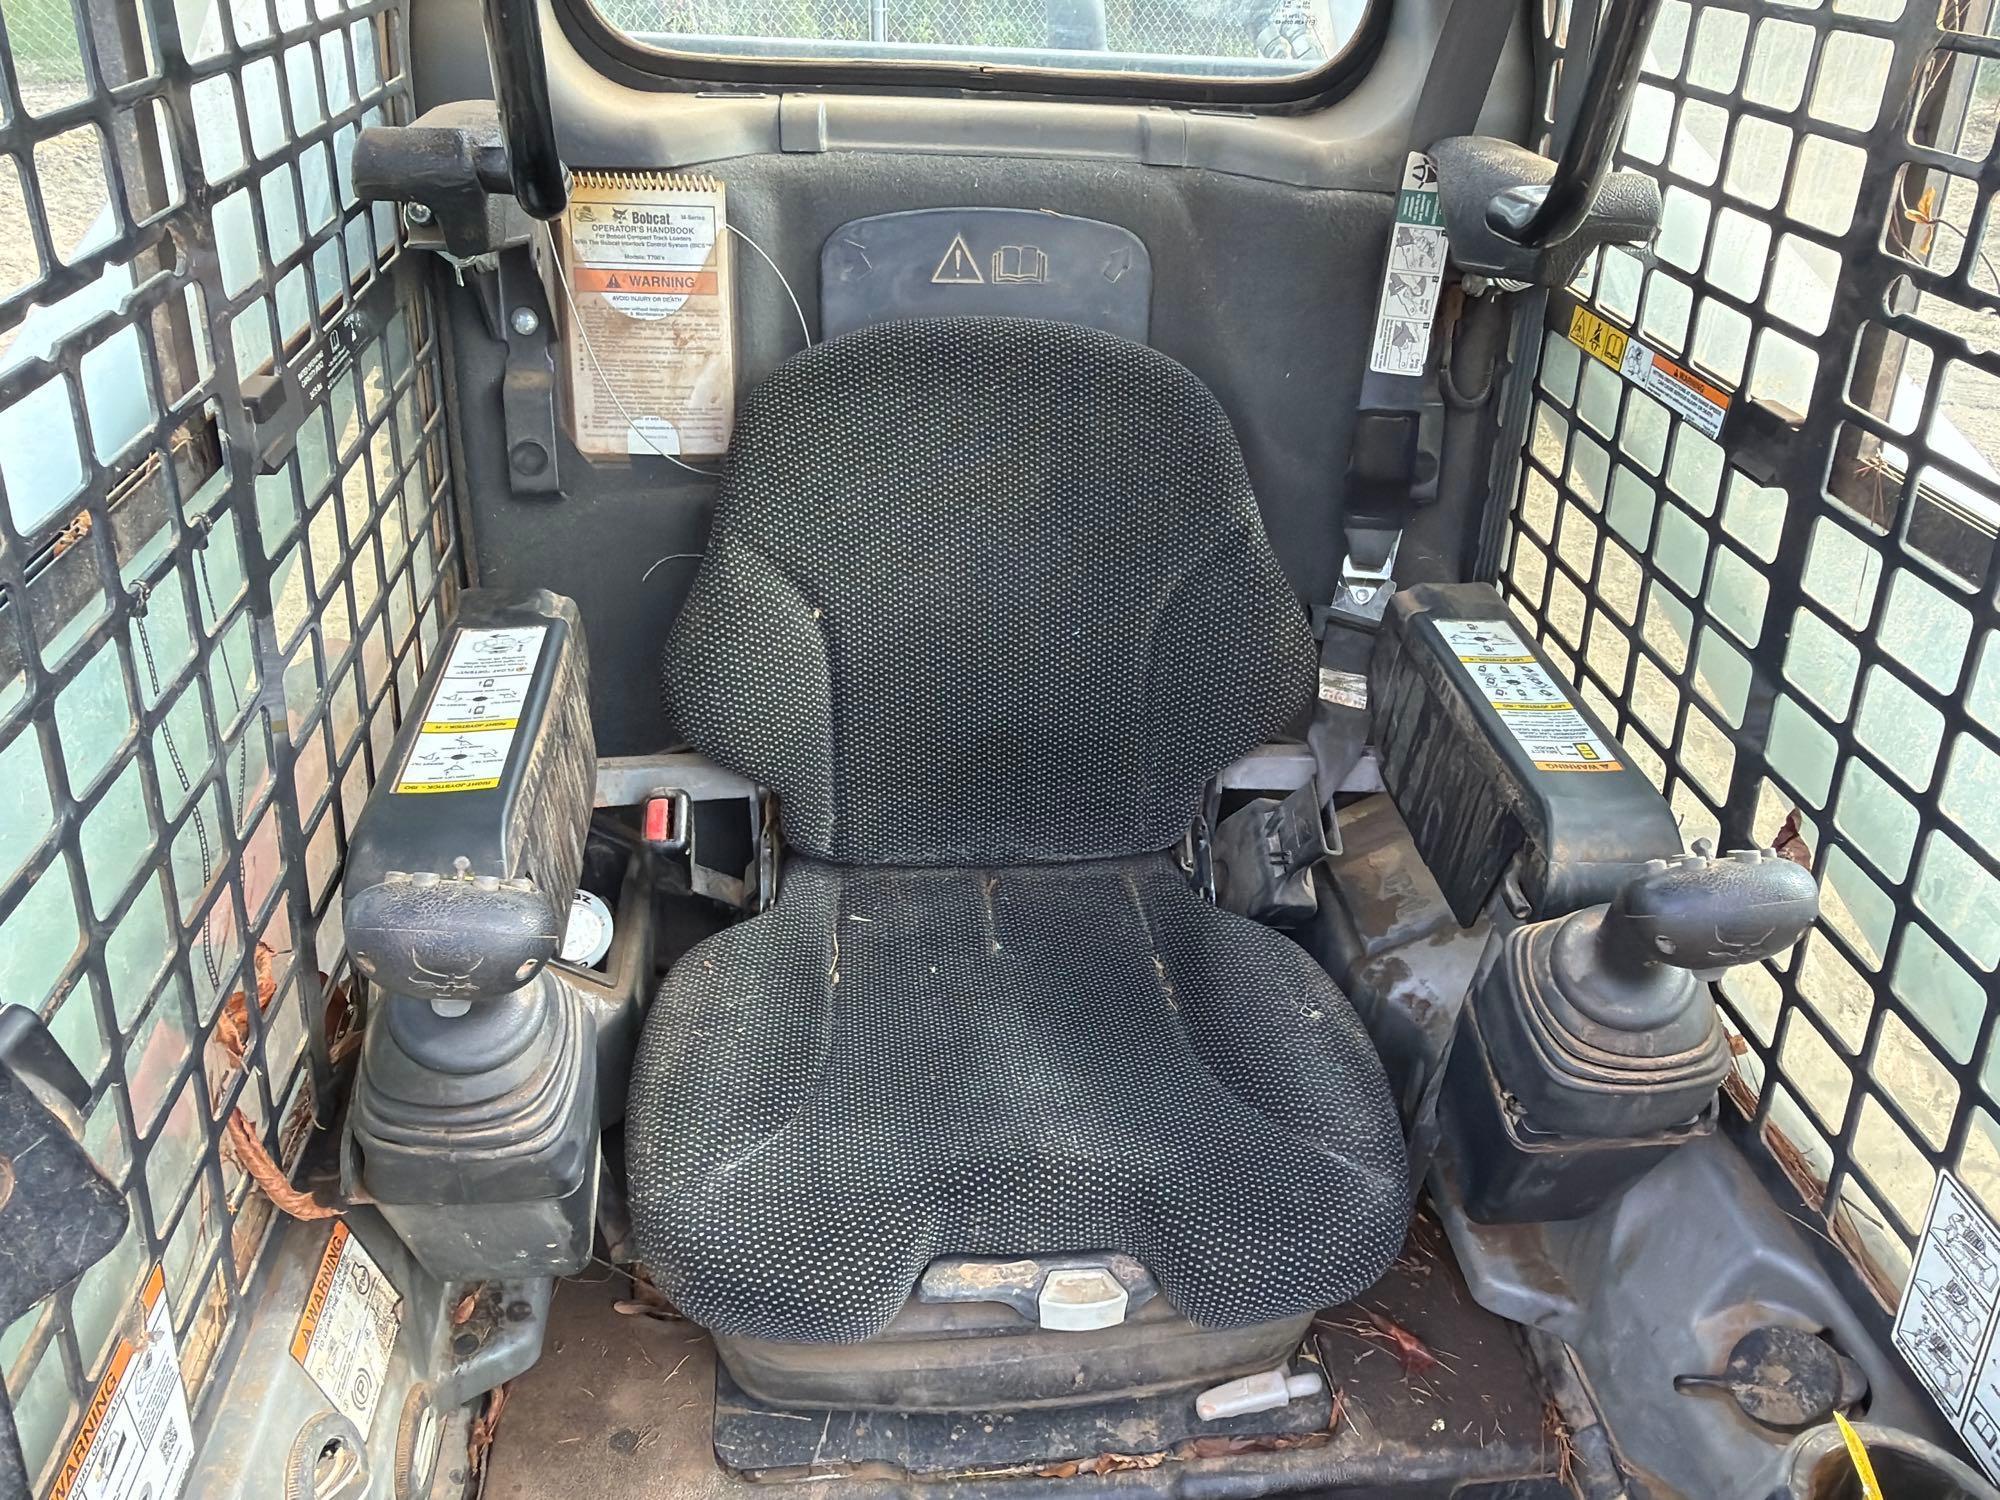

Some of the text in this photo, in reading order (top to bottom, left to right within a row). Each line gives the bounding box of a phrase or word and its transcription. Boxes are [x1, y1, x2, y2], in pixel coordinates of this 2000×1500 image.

[592, 224, 695, 235] OPERATOR'S HANDBOOK
[632, 212, 671, 226] Bobcat
[627, 234, 652, 242] Compact
[629, 275, 696, 288] WARNING
[1679, 372, 1704, 394] WARNING
[426, 782, 466, 790] JOYSTICK
[1951, 1192, 1974, 1222] ENTERING
[1975, 1220, 1985, 1233] THE
[306, 1236, 343, 1324] WARNING
[1934, 1244, 1990, 1315] OPERATING THE LOADER
[313, 1322, 324, 1347] AVOID
[322, 1294, 333, 1319] INJURY
[337, 1254, 347, 1279] DEATH
[324, 1314, 334, 1338] LEAVE
[1920, 1300, 1970, 1365] LEAVING THE LOADER
[91, 1435, 102, 1457] OR
[102, 1388, 122, 1434] DEATH
